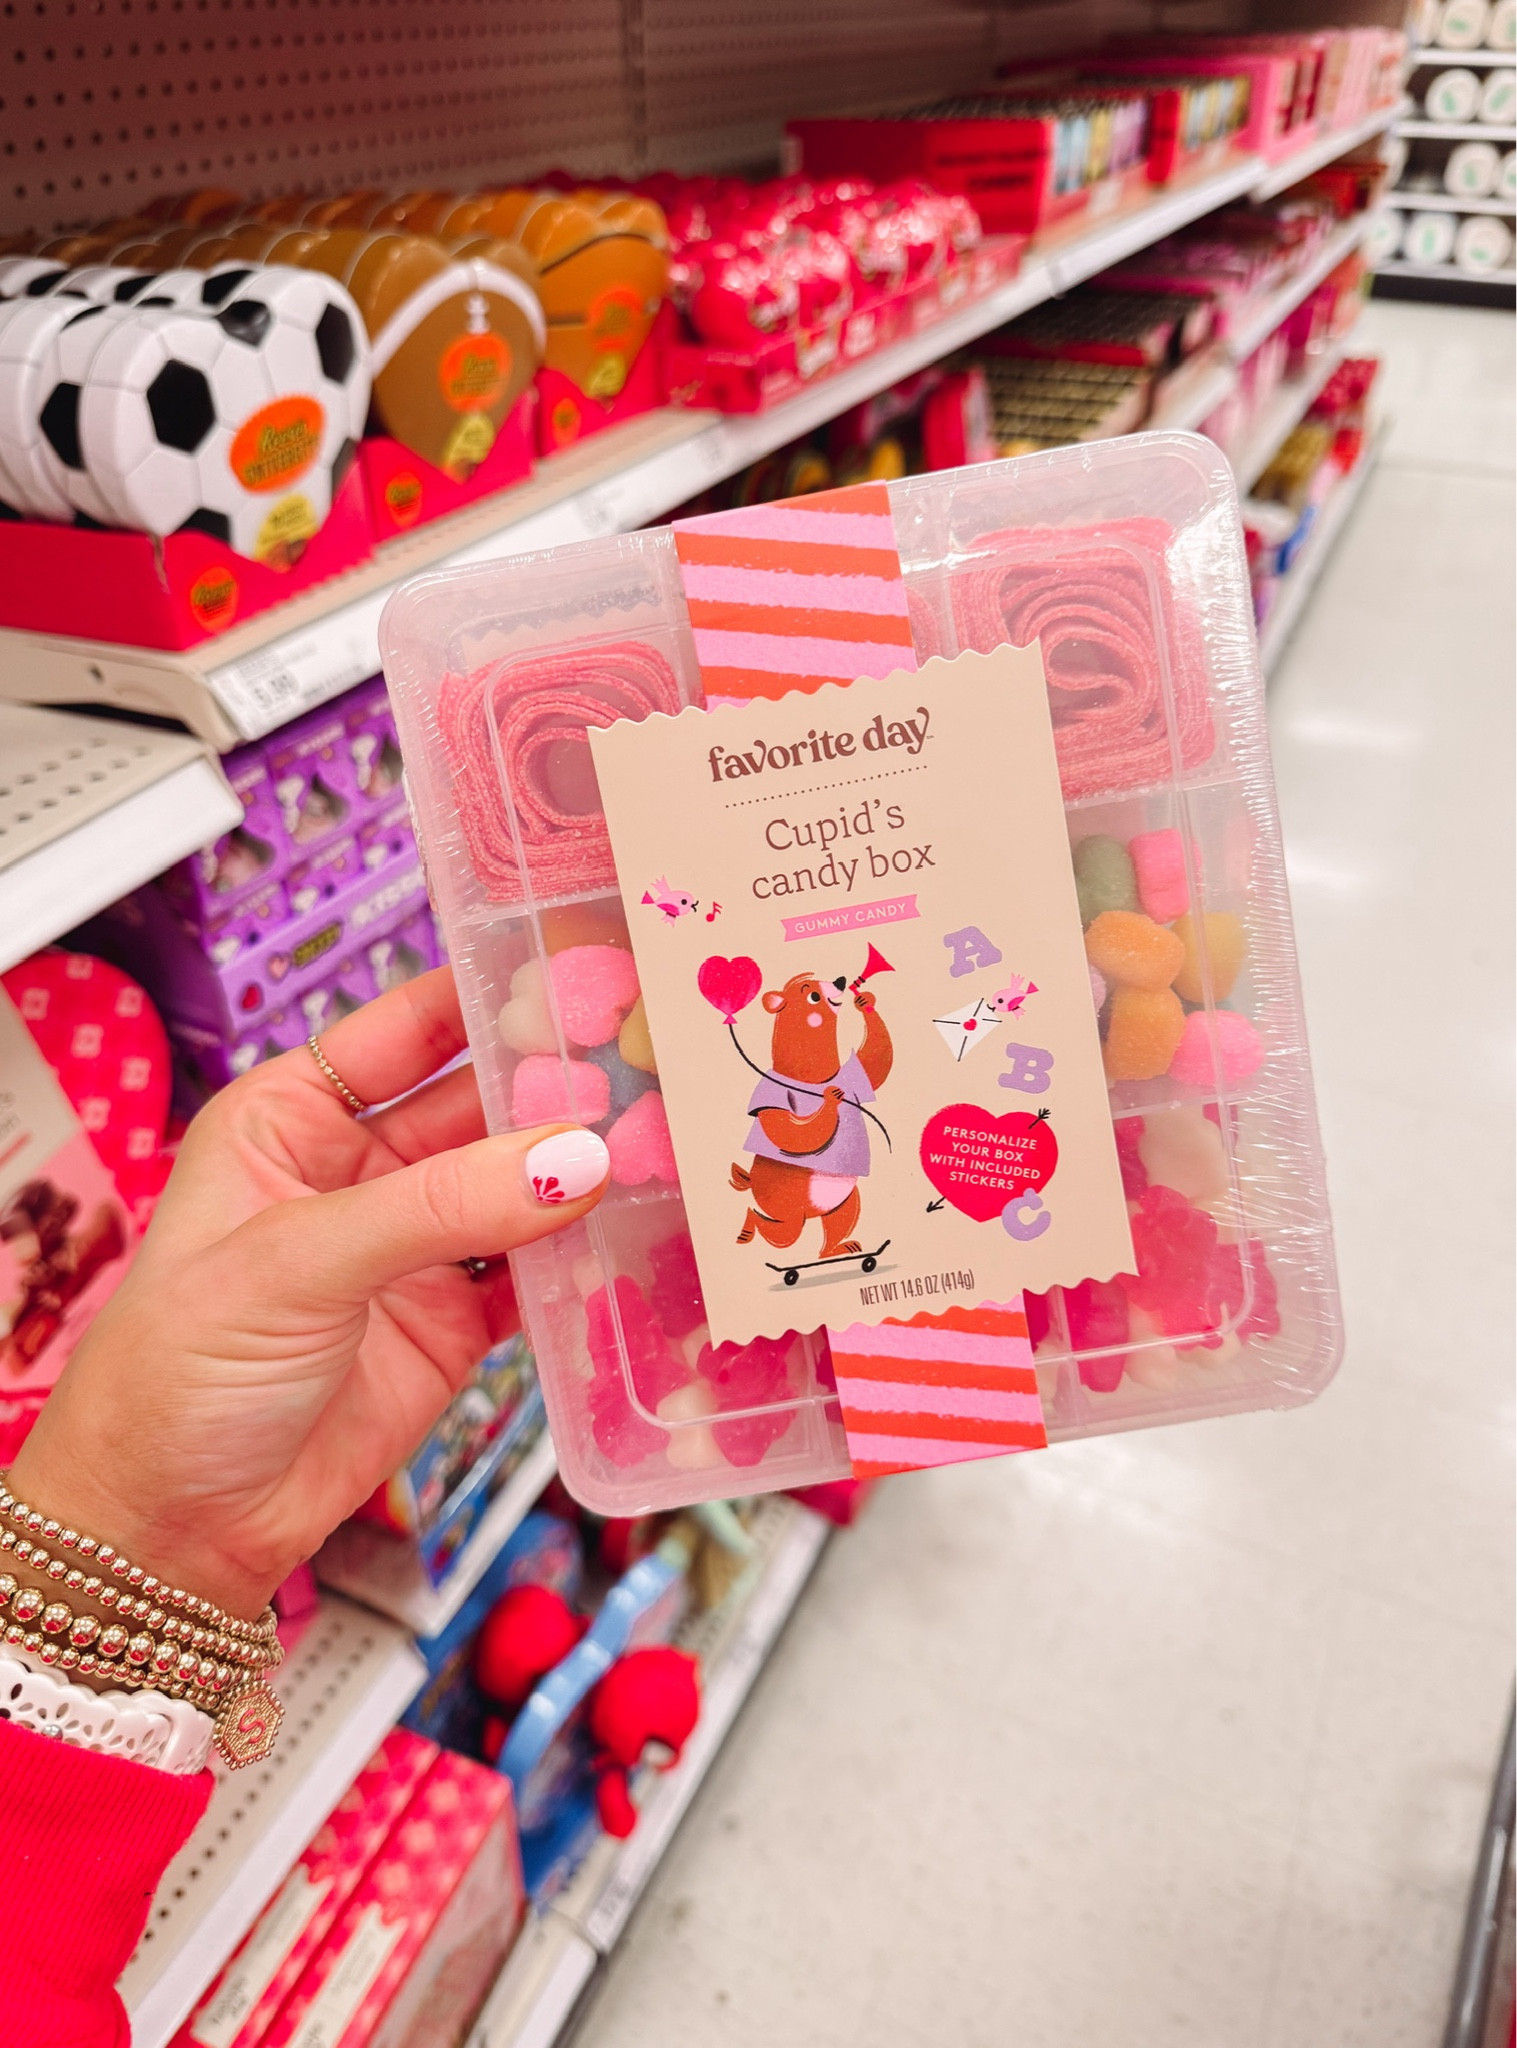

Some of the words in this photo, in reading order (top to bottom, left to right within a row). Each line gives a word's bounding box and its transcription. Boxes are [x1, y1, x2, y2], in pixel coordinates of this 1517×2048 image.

[708, 729, 857, 782] favorite
[862, 706, 930, 755] day
[765, 799, 905, 851] Cupid's
[752, 853, 859, 899] candy
[866, 845, 936, 878] box
[794, 914, 850, 934] GUMMY
[855, 903, 907, 923] CANDY
[943, 926, 1002, 978] A
[997, 1042, 1054, 1094] B
[943, 1126, 1037, 1150] PERSONALIZE
[952, 1142, 990, 1157] YOUR
[994, 1149, 1024, 1162] BOX
[930, 1153, 965, 1168] WITH
[970, 1160, 1040, 1179] INCLUDED
[949, 1171, 1015, 1190] STICKERS
[859, 1285, 880, 1306] NET
[880, 1282, 899, 1302] WT
[900, 1277, 923, 1299] 14.6
[925, 1274, 940, 1295] OZ
[941, 1268, 975, 1294] (414g)
